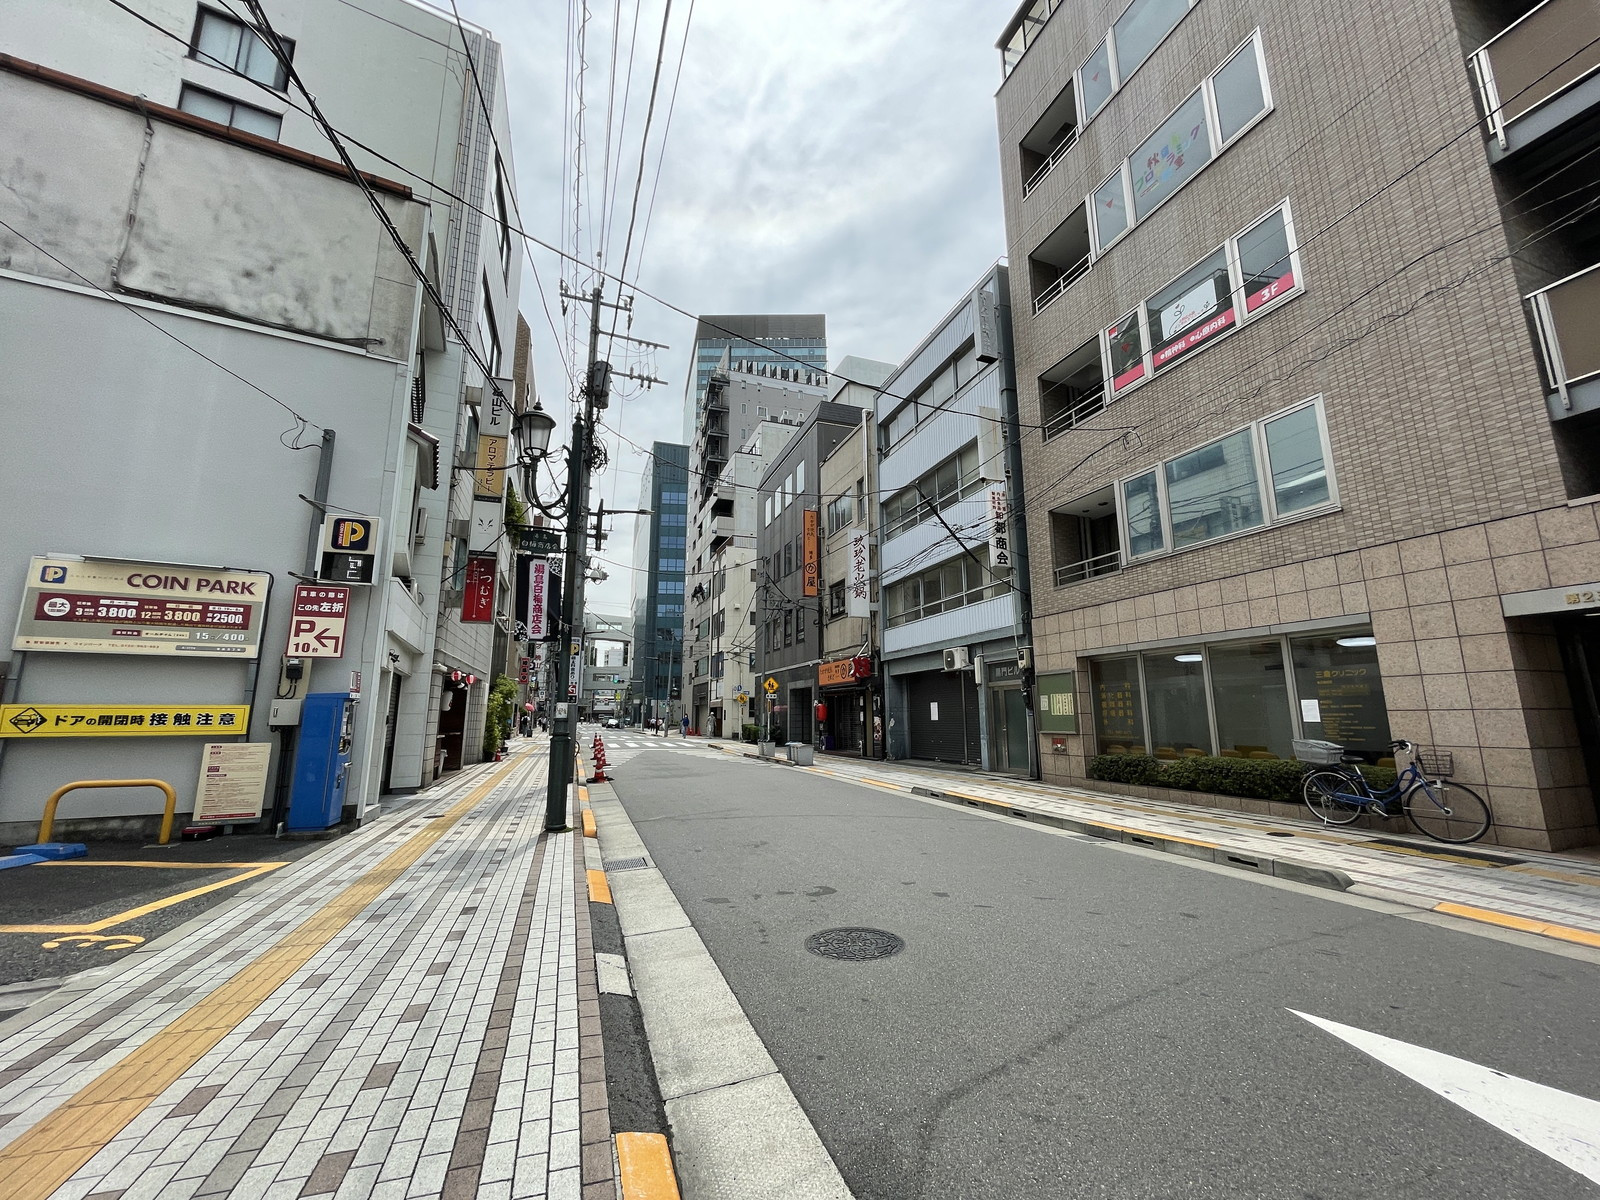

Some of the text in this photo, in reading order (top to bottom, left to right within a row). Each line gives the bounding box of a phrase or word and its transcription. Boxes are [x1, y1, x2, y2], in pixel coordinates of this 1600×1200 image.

[1260, 282, 1280, 302] 3F
[1195, 315, 1227, 340] 心療内科
[485, 439, 498, 492] アロマテラピー
[342, 522, 365, 547] P
[127, 573, 257, 596] COIN PARK
[478, 574, 493, 609] つむぎ
[297, 601, 344, 613] この先左折
[531, 563, 546, 635] 湯島白梅商店会
[141, 611, 152, 619] 12
[293, 619, 317, 638] P
[293, 642, 319, 653] 10台
[54, 712, 237, 727] ドアの開閉時 接触注意
